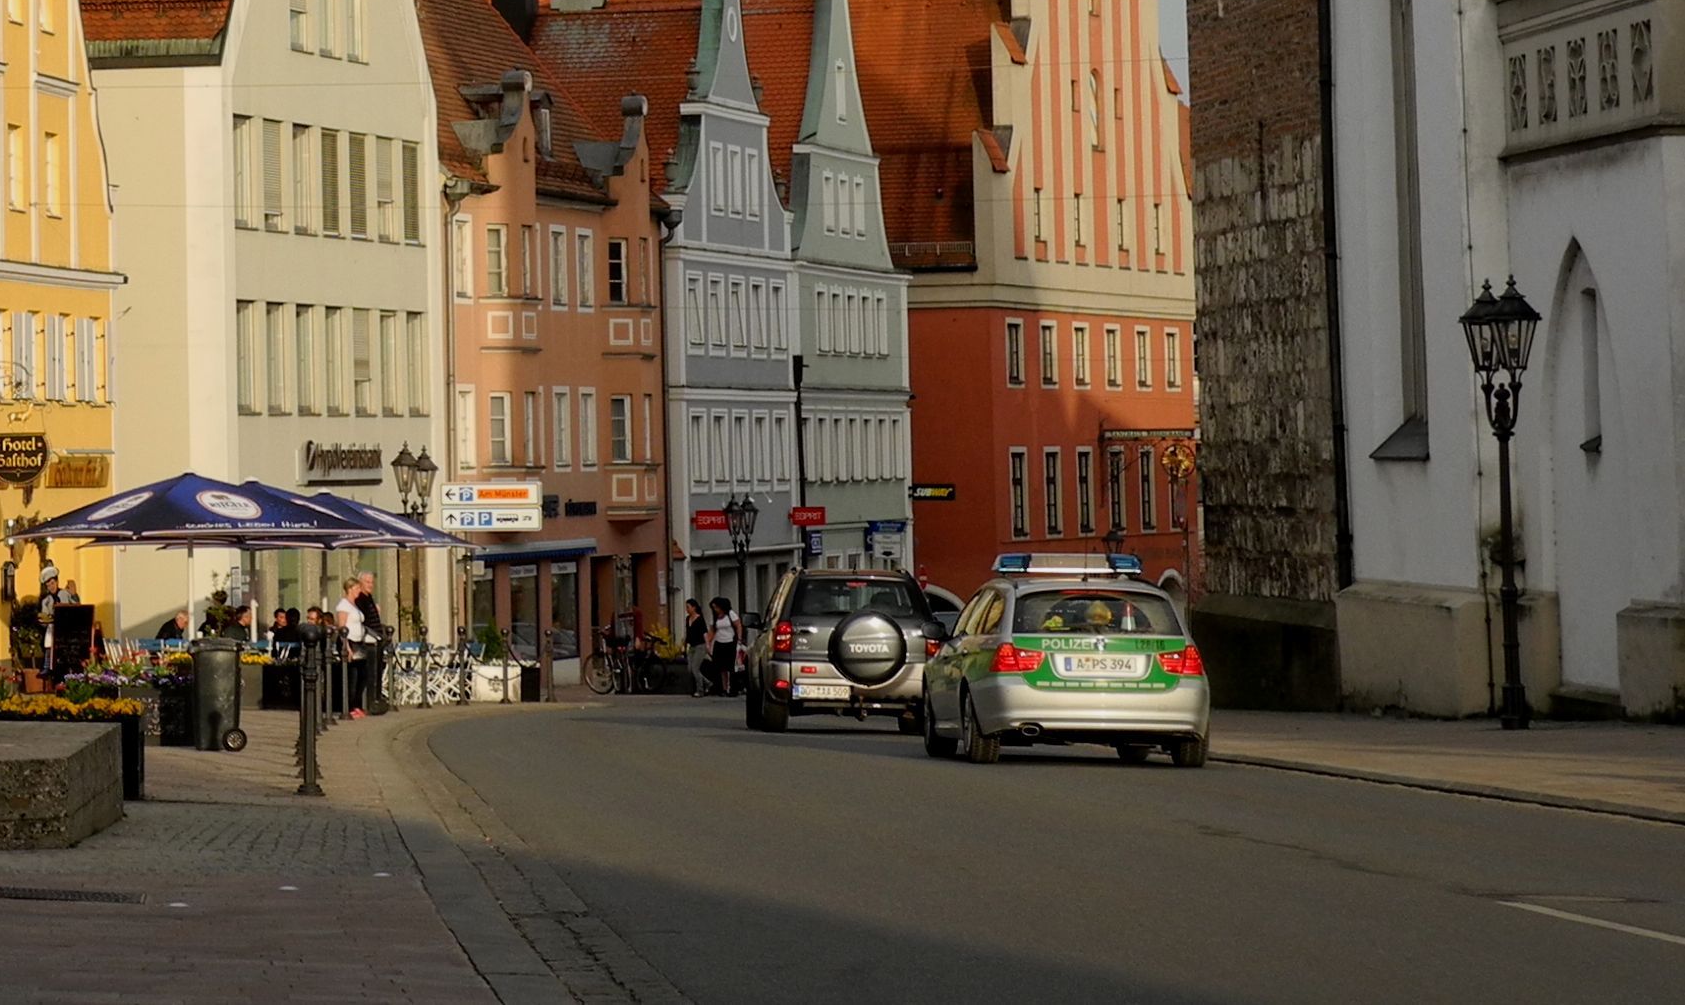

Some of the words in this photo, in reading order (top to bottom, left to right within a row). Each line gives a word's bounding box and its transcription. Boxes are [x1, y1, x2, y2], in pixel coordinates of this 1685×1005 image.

[2, 437, 36, 452] Hotel
[315, 442, 383, 477] HypoVereinsbank
[478, 489, 493, 499] Am
[494, 489, 527, 499] Münster
[913, 487, 953, 497] SUBWAY
[794, 511, 822, 521] ESPRIT
[848, 643, 889, 654] TOYOTA
